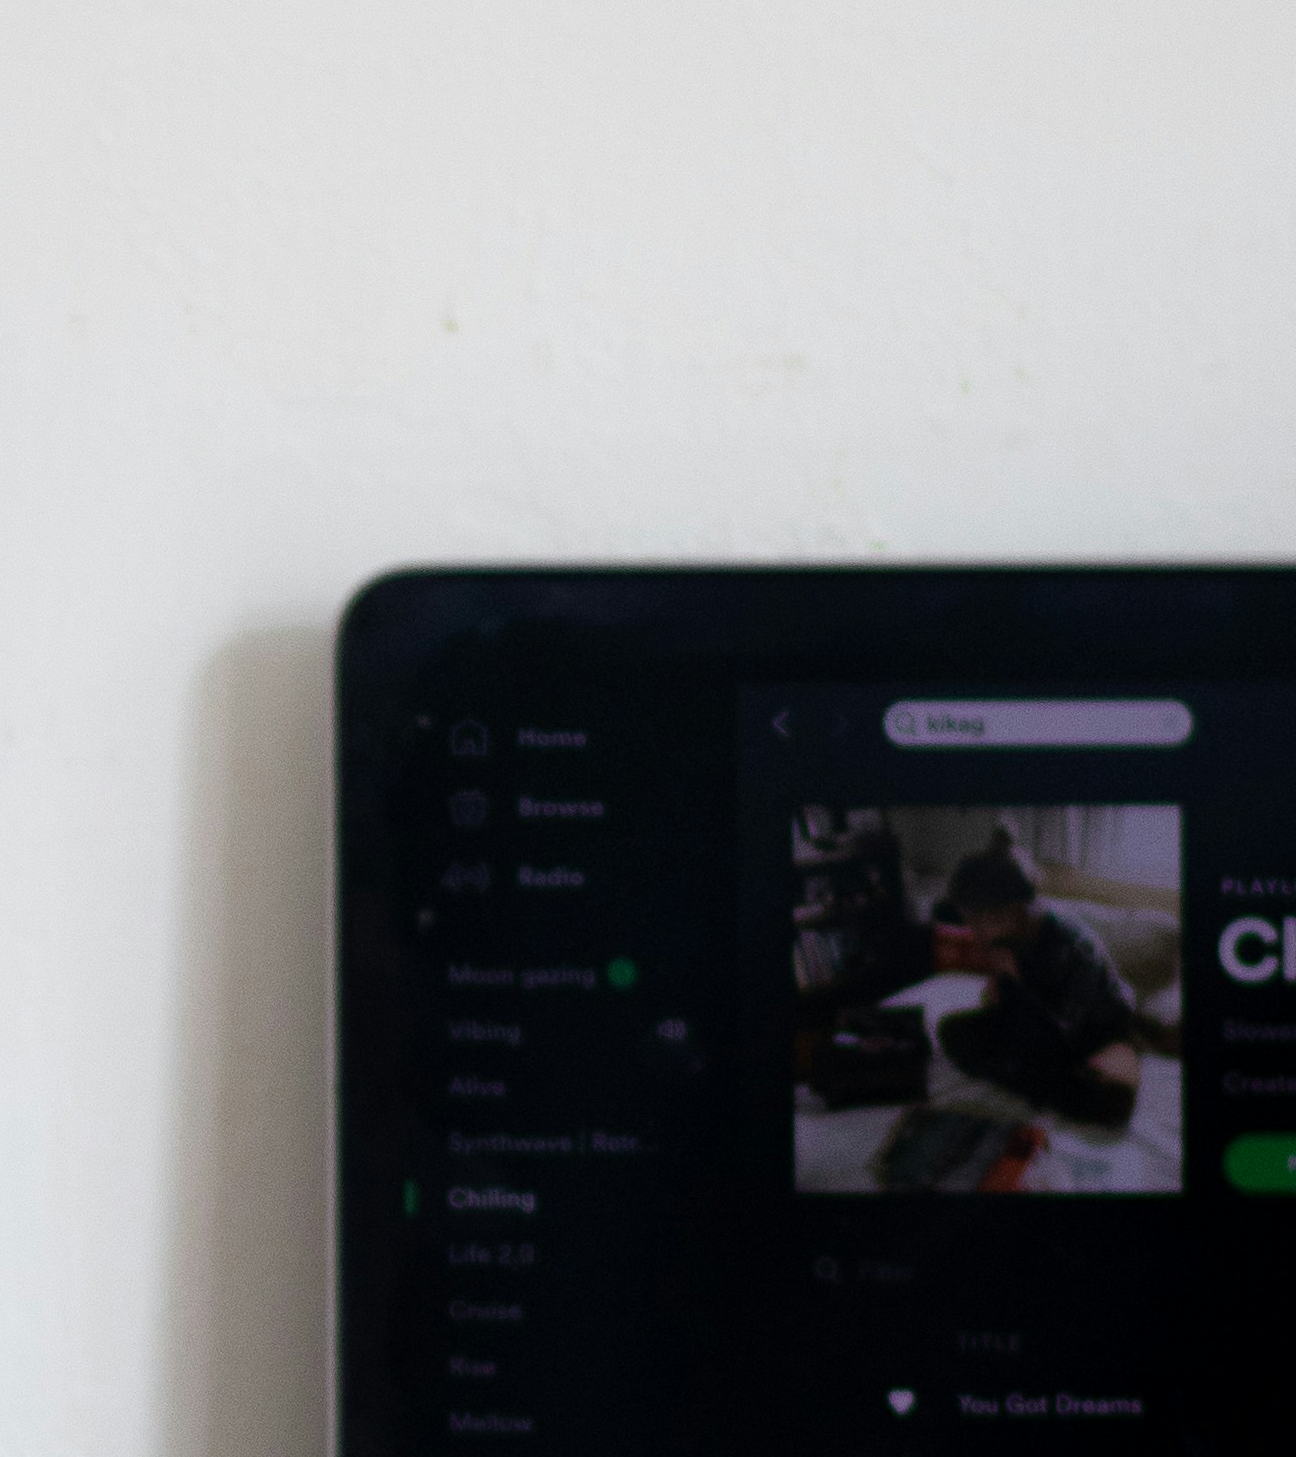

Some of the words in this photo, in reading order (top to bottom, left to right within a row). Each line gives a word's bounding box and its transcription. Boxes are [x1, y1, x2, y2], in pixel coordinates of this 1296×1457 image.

[516, 726, 588, 749] Home
[517, 795, 606, 819] Browse
[517, 864, 586, 888] Radio
[448, 1020, 523, 1047] Vibing
[447, 1131, 573, 1156] Synthwave
[447, 1185, 538, 1215] Chilling
[956, 1392, 1000, 1417] You
[1005, 1392, 1049, 1417] Got
[1054, 1392, 1144, 1417] Dreams
